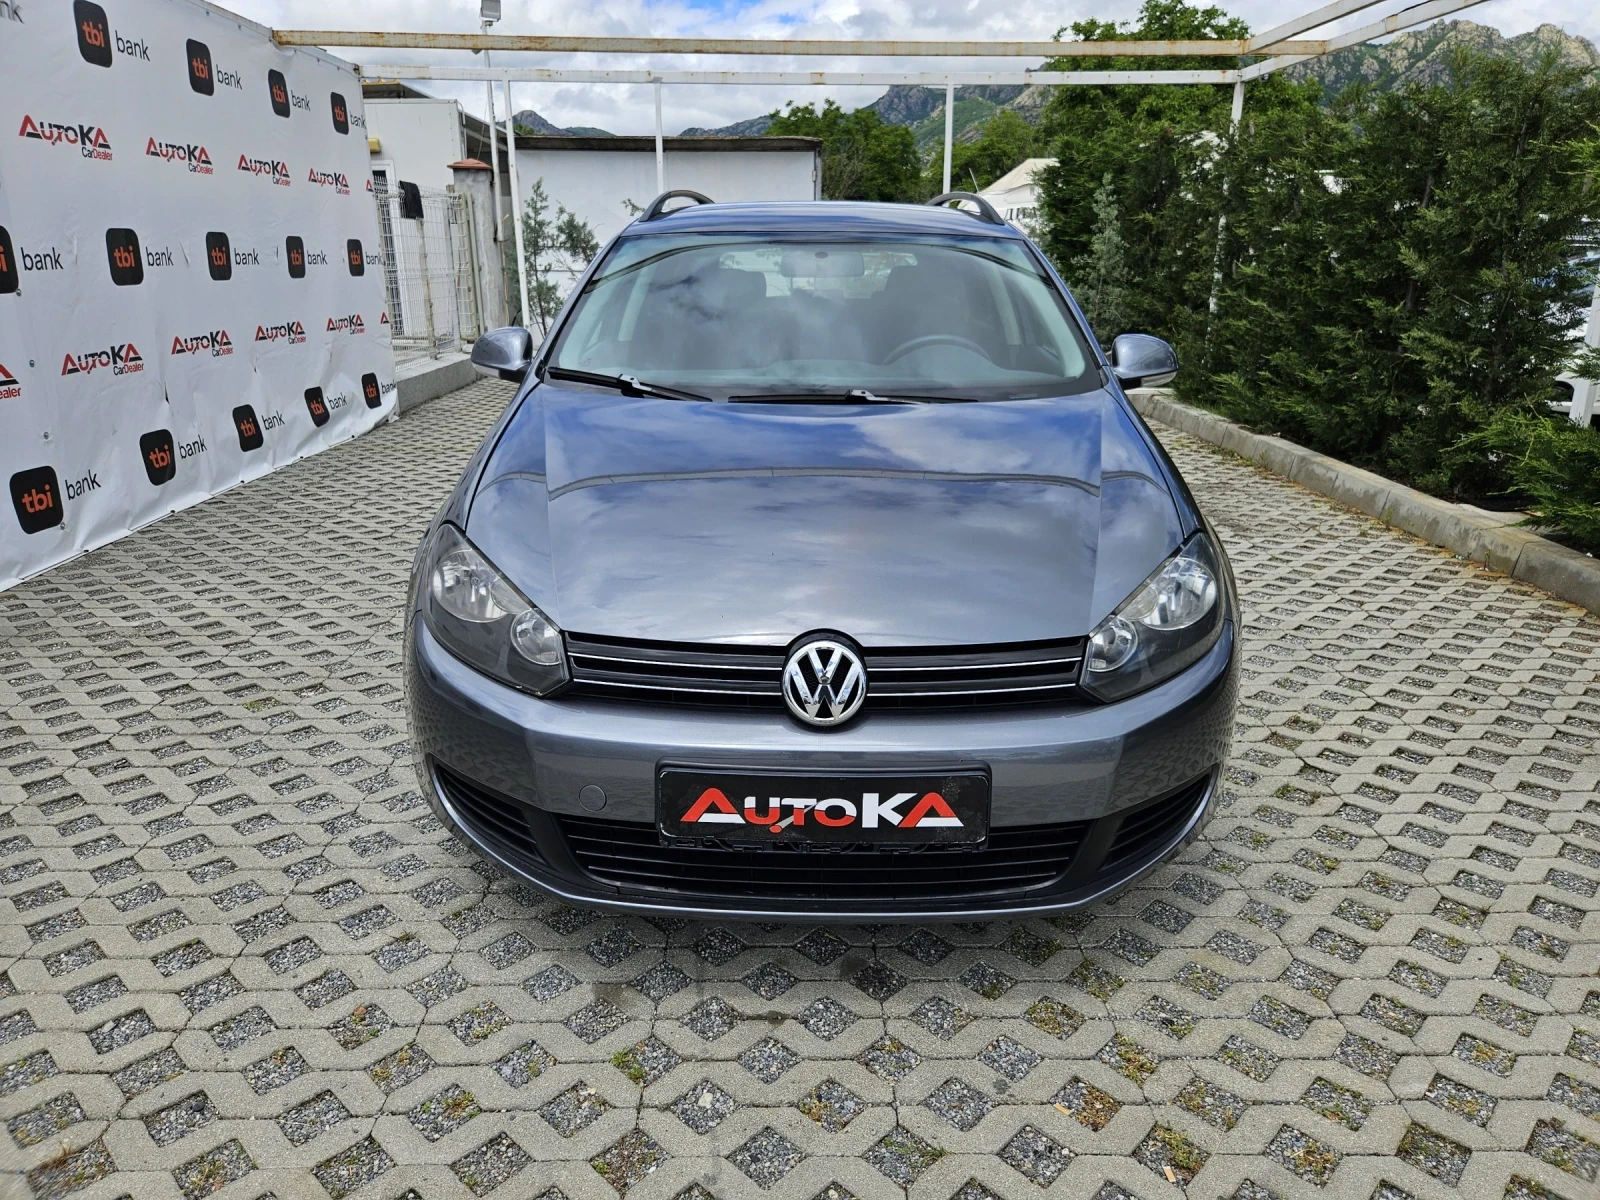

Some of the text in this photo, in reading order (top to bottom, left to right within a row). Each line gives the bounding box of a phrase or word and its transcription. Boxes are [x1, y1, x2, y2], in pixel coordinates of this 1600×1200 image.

[82, 21, 150, 62] tbi bank
[192, 57, 243, 90] tbi bank
[272, 85, 312, 112] tbi bank
[334, 106, 346, 122] tbi
[21, 246, 64, 272] bank
[113, 245, 174, 269] tbi bank
[211, 247, 260, 266] tbi bank
[290, 249, 328, 266] tbi bank
[350, 250, 362, 266] tbi
[366, 383, 377, 398] tbi
[310, 392, 348, 416] tbi bank
[240, 410, 286, 438] tbi bank
[149, 434, 208, 469] tbi bank
[22, 469, 102, 514] tbi bank
